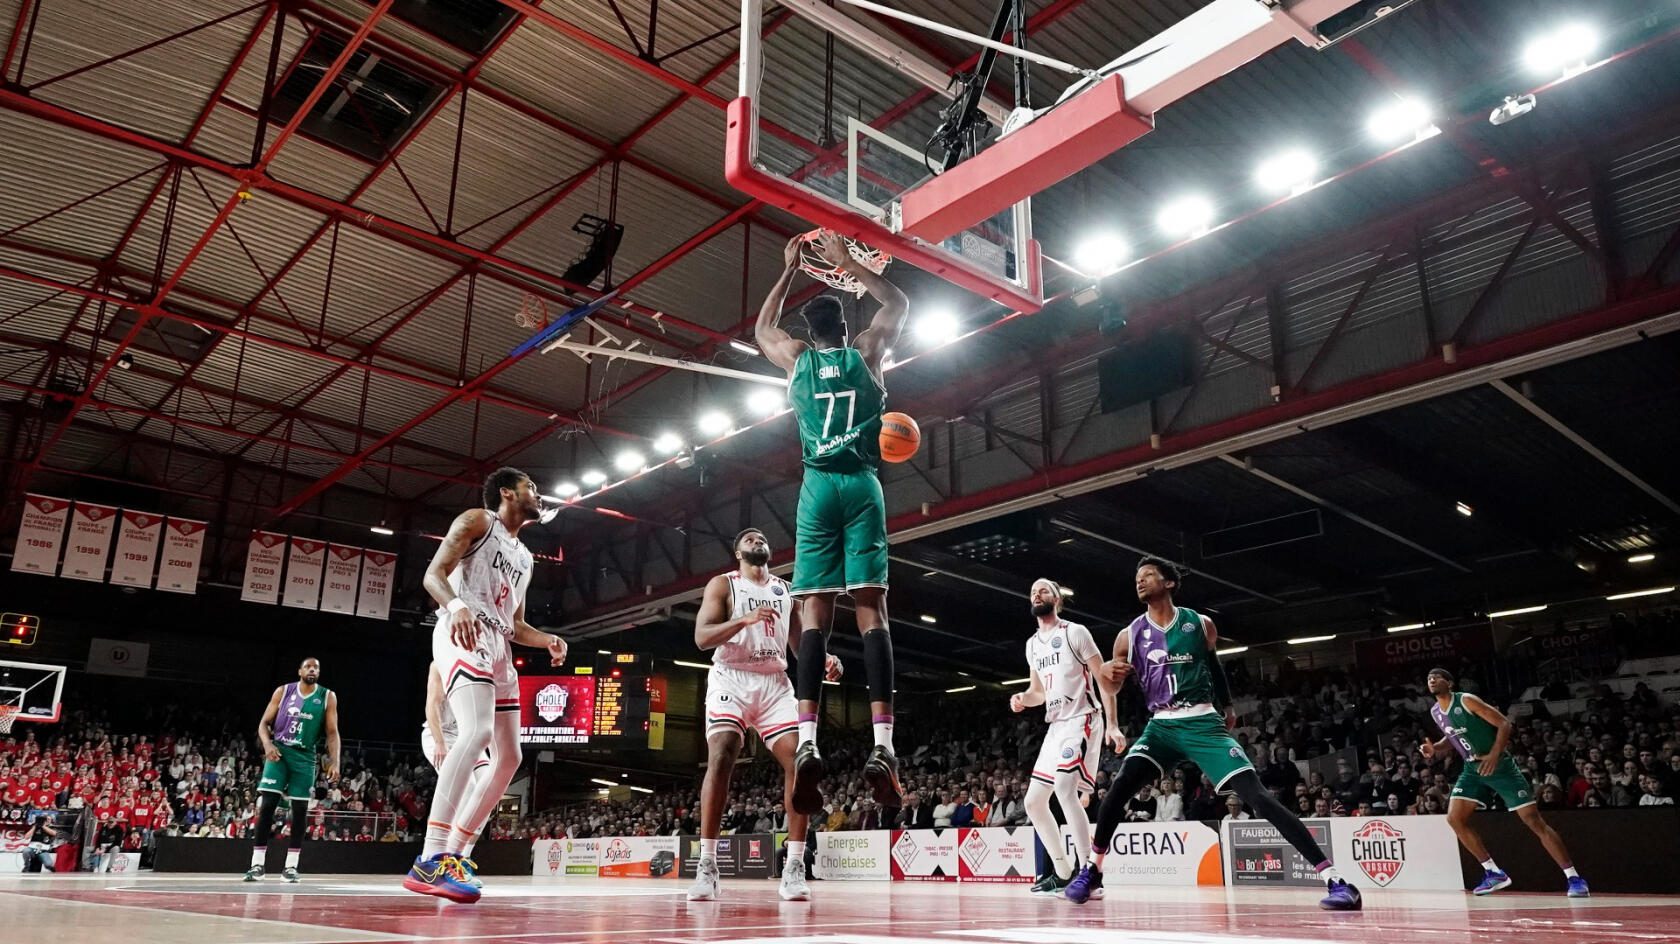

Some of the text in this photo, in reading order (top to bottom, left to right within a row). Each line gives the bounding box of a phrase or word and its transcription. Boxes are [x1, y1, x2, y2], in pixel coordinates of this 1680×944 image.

[818, 365, 841, 379] SIMA
[815, 390, 855, 439] 77
[75, 546, 101, 555] 1998
[124, 553, 148, 562] 1999
[168, 559, 192, 568] 2008
[492, 550, 523, 588] CHOLET
[292, 577, 314, 585] 2010
[1165, 674, 1178, 695] 11
[537, 693, 567, 706] CHOLET
[289, 721, 304, 734] 34
[1459, 737, 1472, 751] 6
[827, 836, 869, 852] Energies
[1065, 831, 1189, 856] FGERAY
[1351, 838, 1406, 861] CHOLET
[820, 855, 877, 869] Choletaises
[1292, 862, 1305, 870] les
[1366, 862, 1397, 872] BASKET
[1119, 863, 1178, 875] d'assurances
[1292, 871, 1303, 879] de
